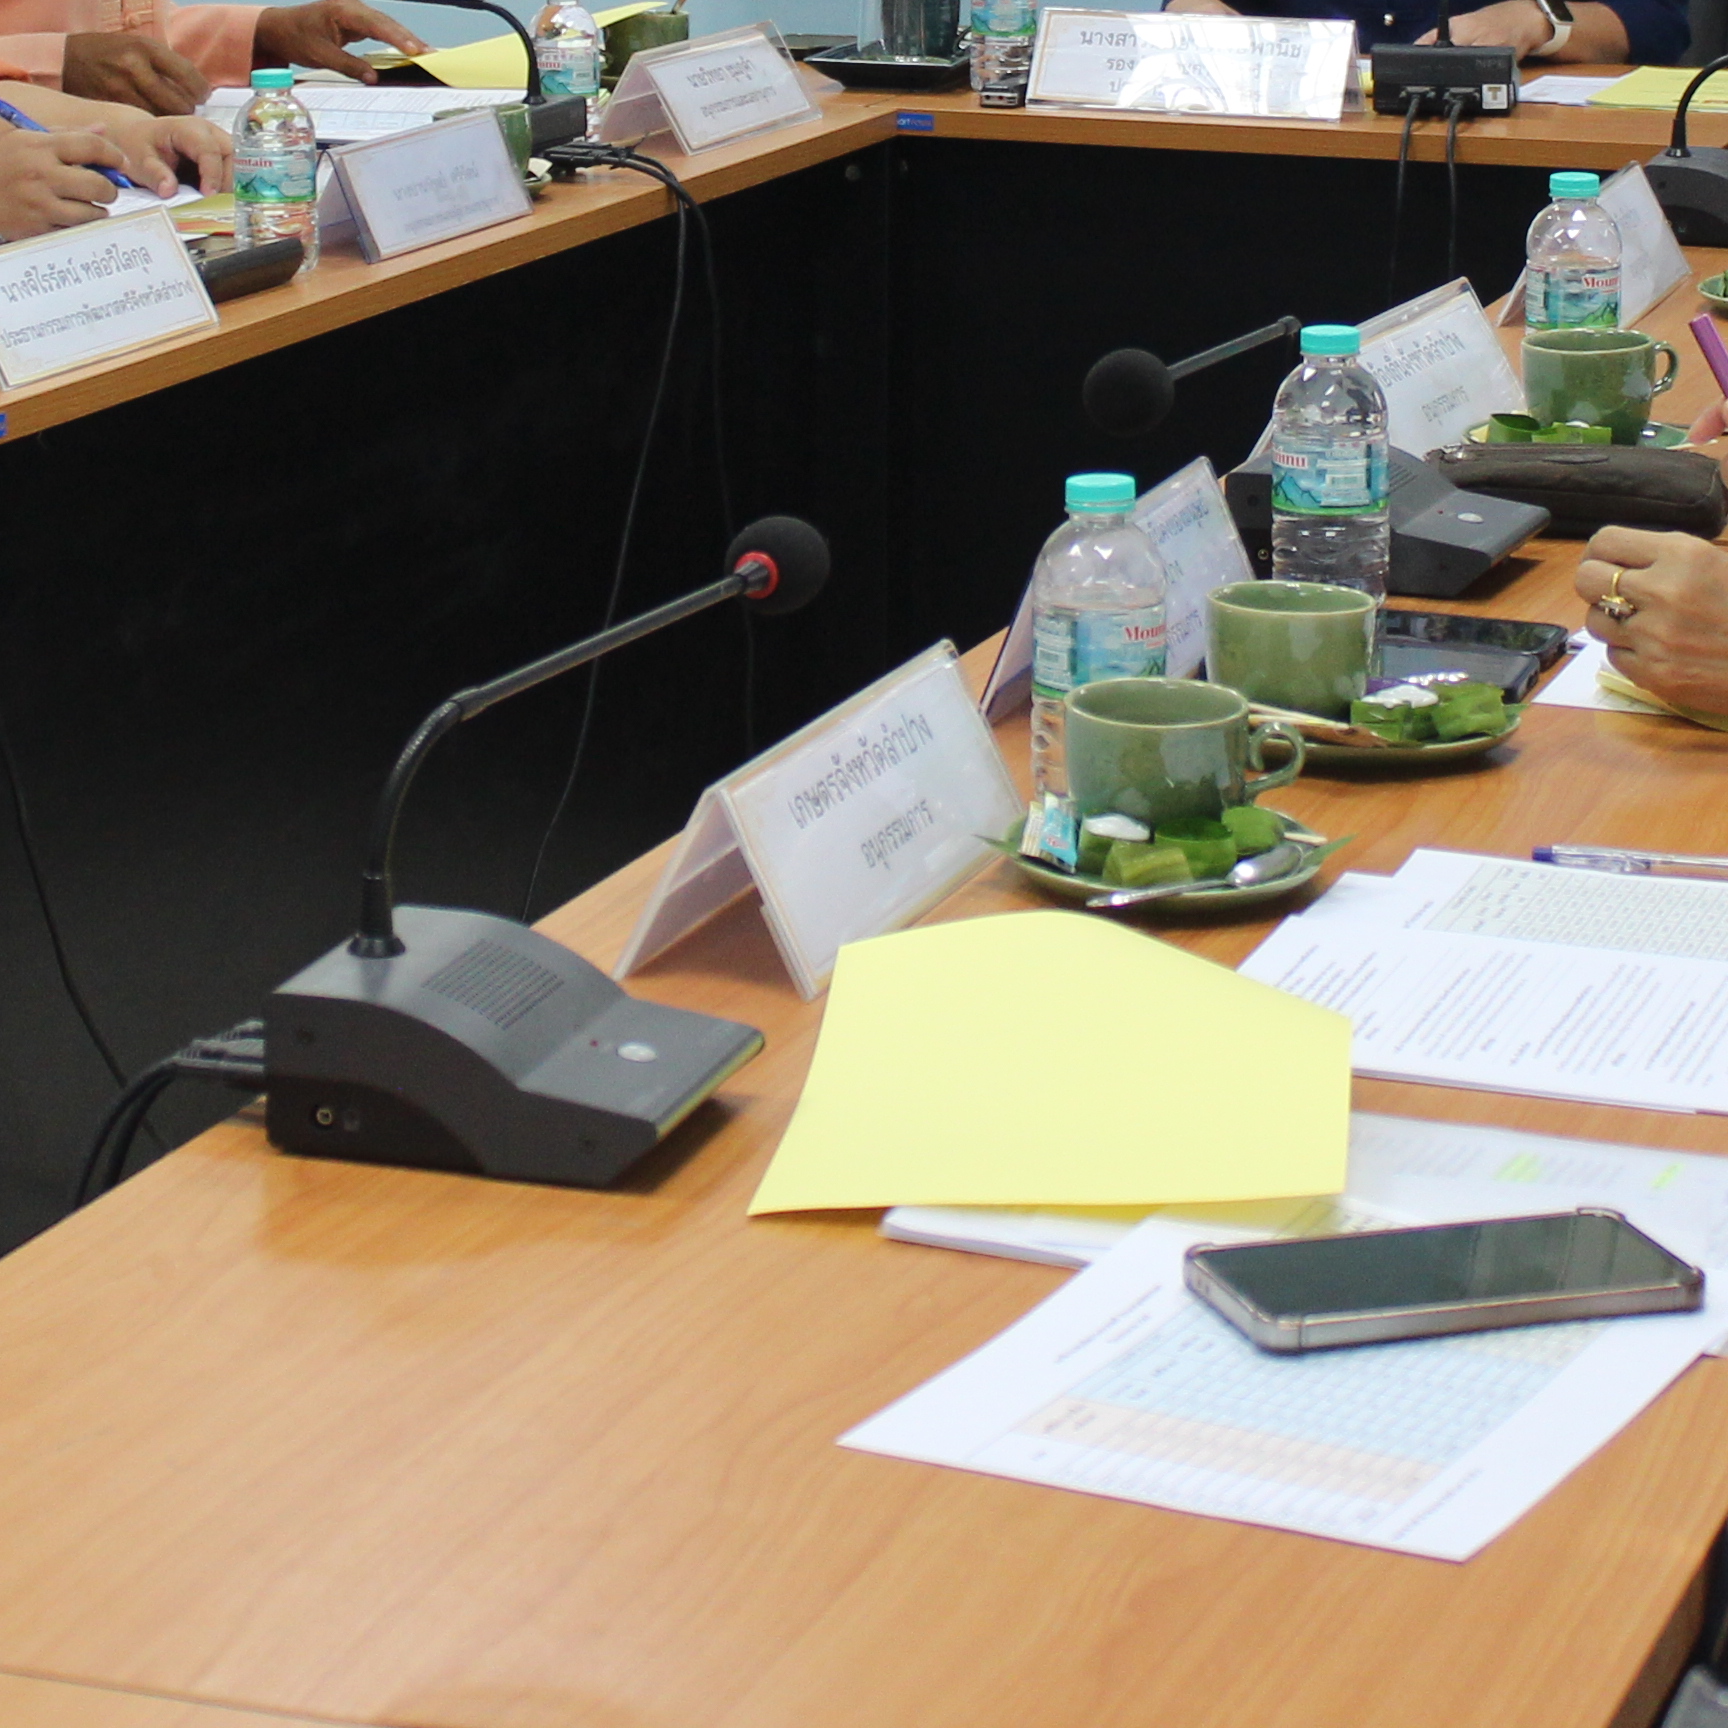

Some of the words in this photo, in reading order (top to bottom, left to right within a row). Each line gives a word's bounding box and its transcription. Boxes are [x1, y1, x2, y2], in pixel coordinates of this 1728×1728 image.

[787, 713, 934, 830] เกษตรจังหวัดลำปาง
[860, 798, 935, 871] อนุกรรมการ
